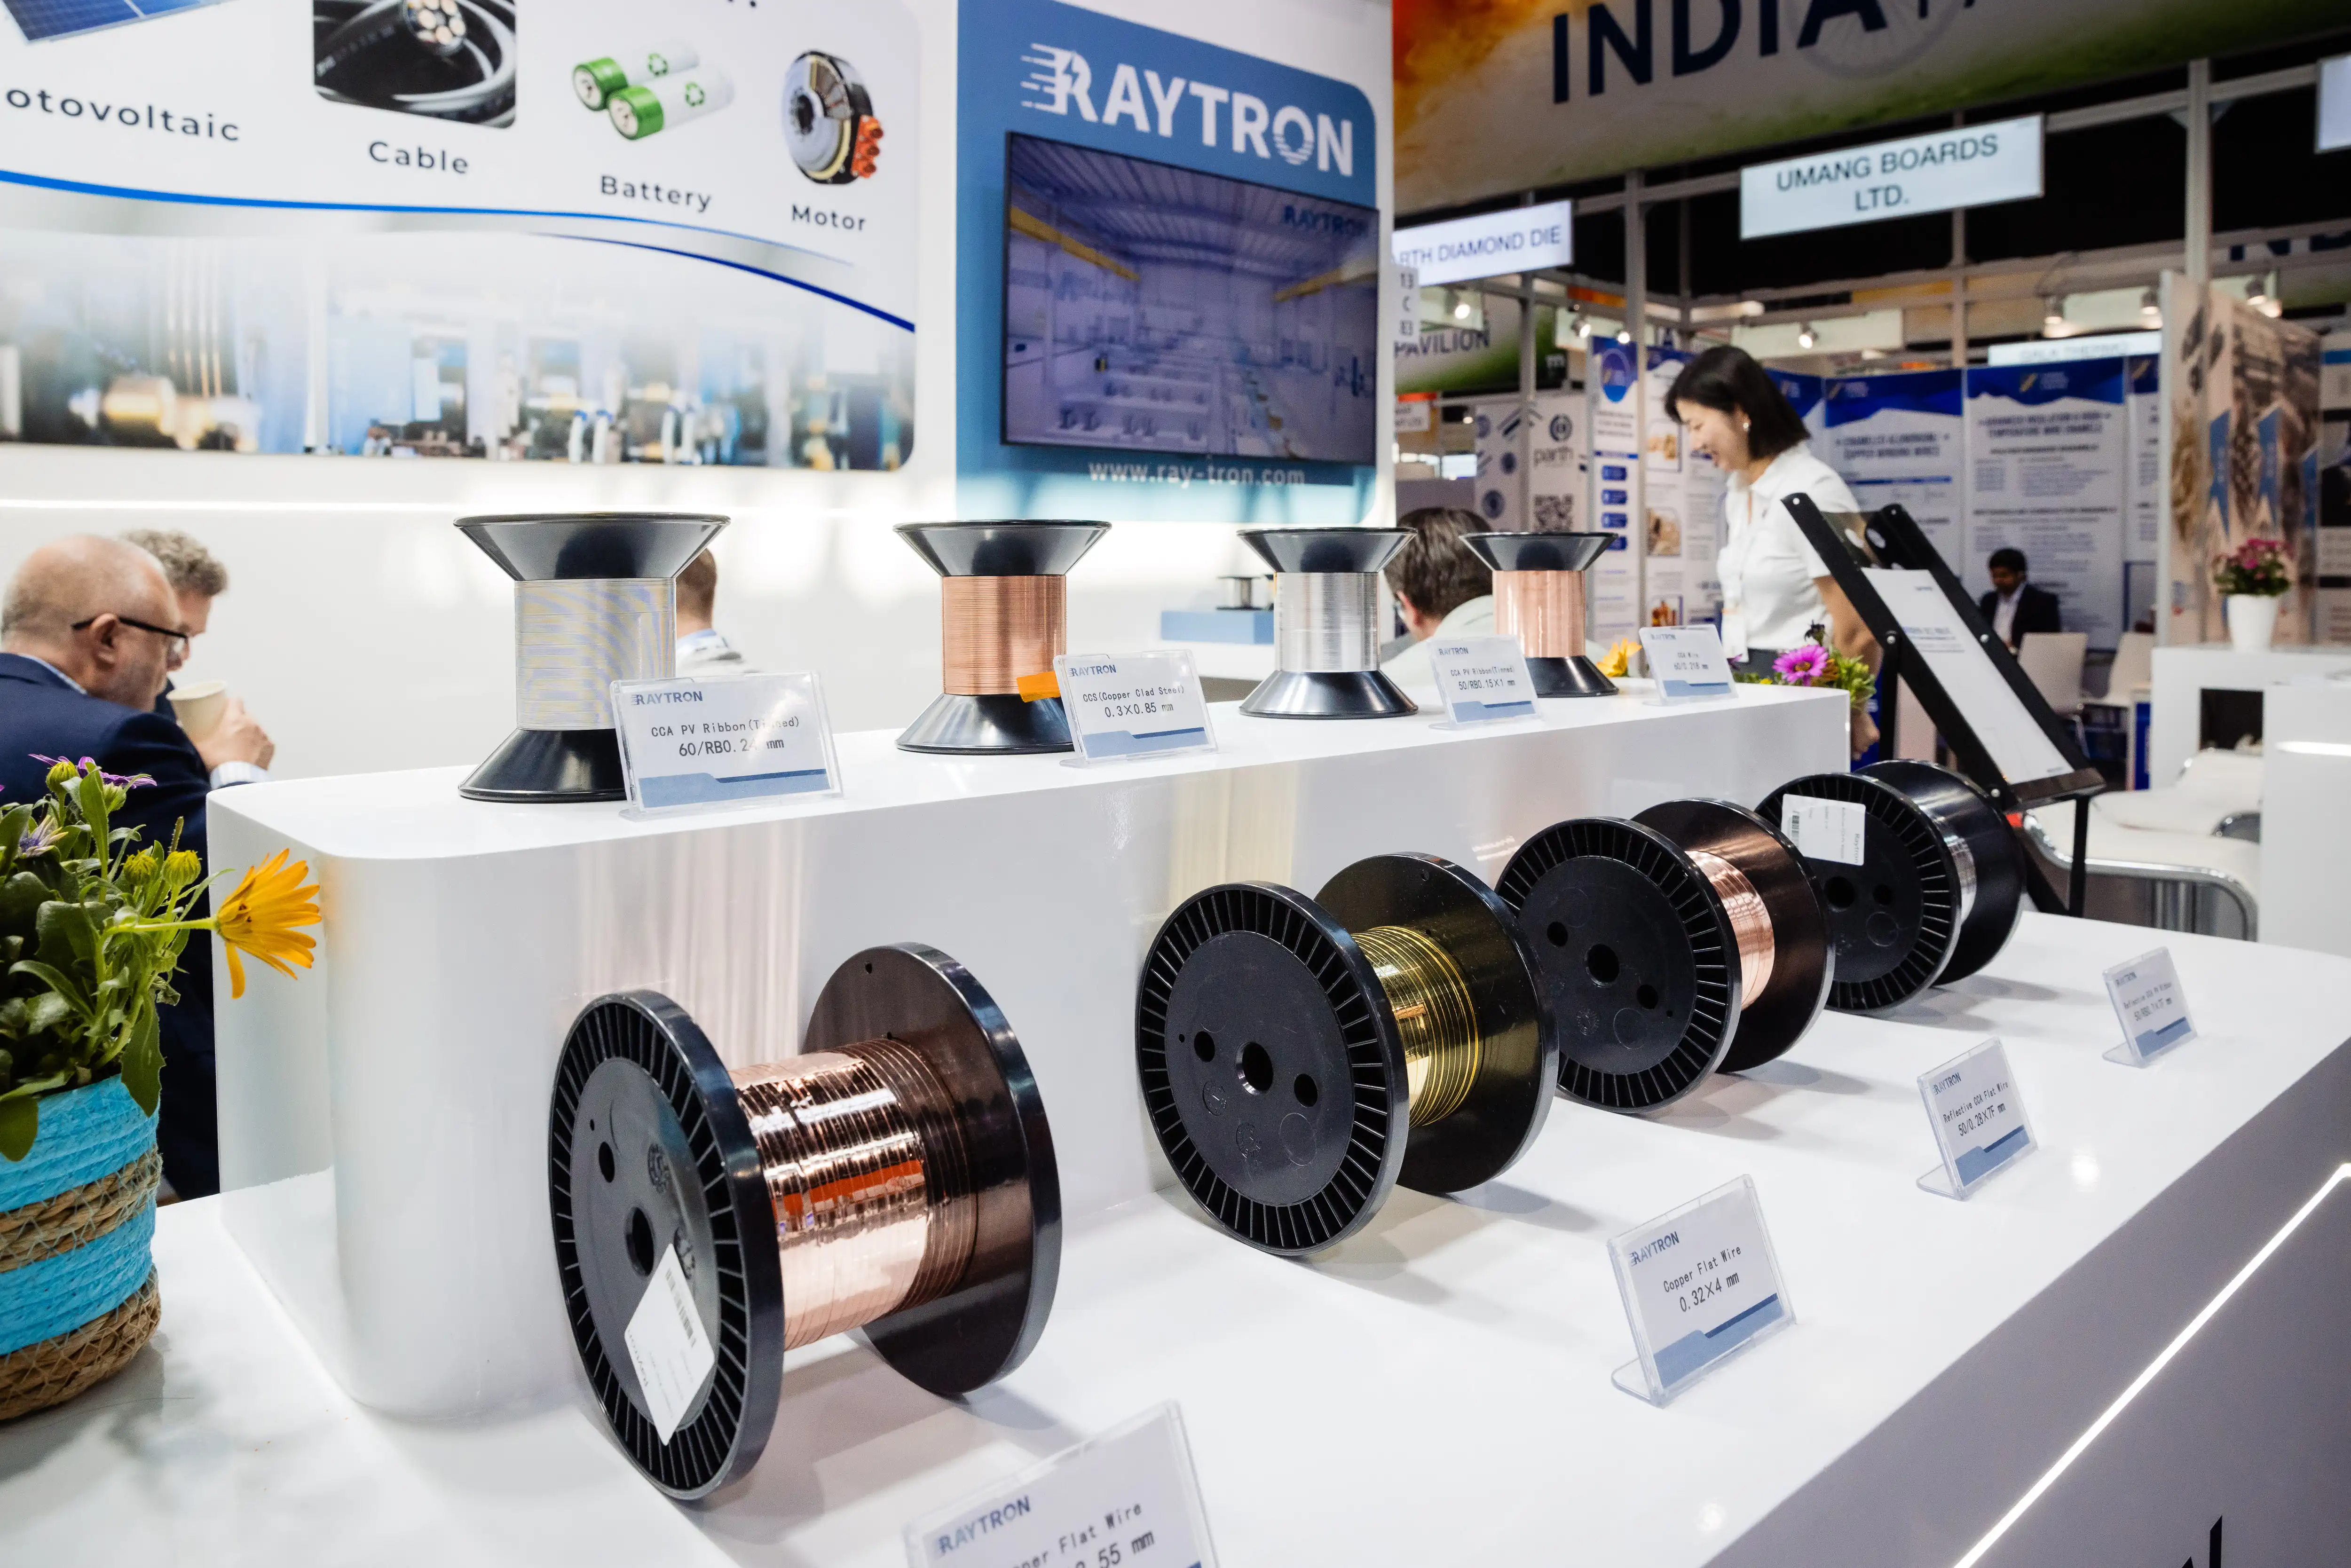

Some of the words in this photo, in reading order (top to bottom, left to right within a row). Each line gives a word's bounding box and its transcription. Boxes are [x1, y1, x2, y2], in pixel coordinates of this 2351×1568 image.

[1020, 43, 1353, 177] RAYTRON
[369, 141, 469, 174] Cable
[1776, 157, 1871, 191] UMANG
[1881, 134, 1998, 173] BOARDS
[600, 175, 711, 212] Battery
[1855, 185, 1909, 212] LTD.
[792, 205, 867, 231] Motor
[1437, 233, 1524, 261] DIAMOND
[1530, 225, 1561, 247] DIE
[1089, 462, 1305, 488] www.ray-tron.com
[1068, 664, 1117, 677] RAYTRON
[631, 691, 703, 705] RAYTRON
[1083, 691, 1130, 702] CCS(Copper
[1136, 687, 1154, 697] Clad
[1159, 685, 1184, 694] Steel)
[1162, 703, 1174, 712] mm
[651, 726, 674, 737] CCA
[681, 725, 694, 735] PV
[766, 739, 784, 749] mm
[1933, 1072, 1961, 1095] RAYTRON
[1943, 1102, 1972, 1124] Reflective
[1973, 1094, 1983, 1106] CCA
[1984, 1087, 1996, 1101] Flat
[1996, 1082, 2009, 1092] Wire
[1997, 1103, 2006, 1113] mm
[1629, 1231, 1680, 1267] RAYTRON
[1664, 1270, 1693, 1293] Copper
[1697, 1257, 1718, 1275] Flat
[1720, 1245, 1741, 1263] Wire
[1726, 1271, 1740, 1288] mm
[936, 1495, 1031, 1557] RAYTRON
[1058, 1525, 1097, 1553] Flat
[1104, 1504, 1142, 1530] Wire
[1131, 1531, 1154, 1555] mm
